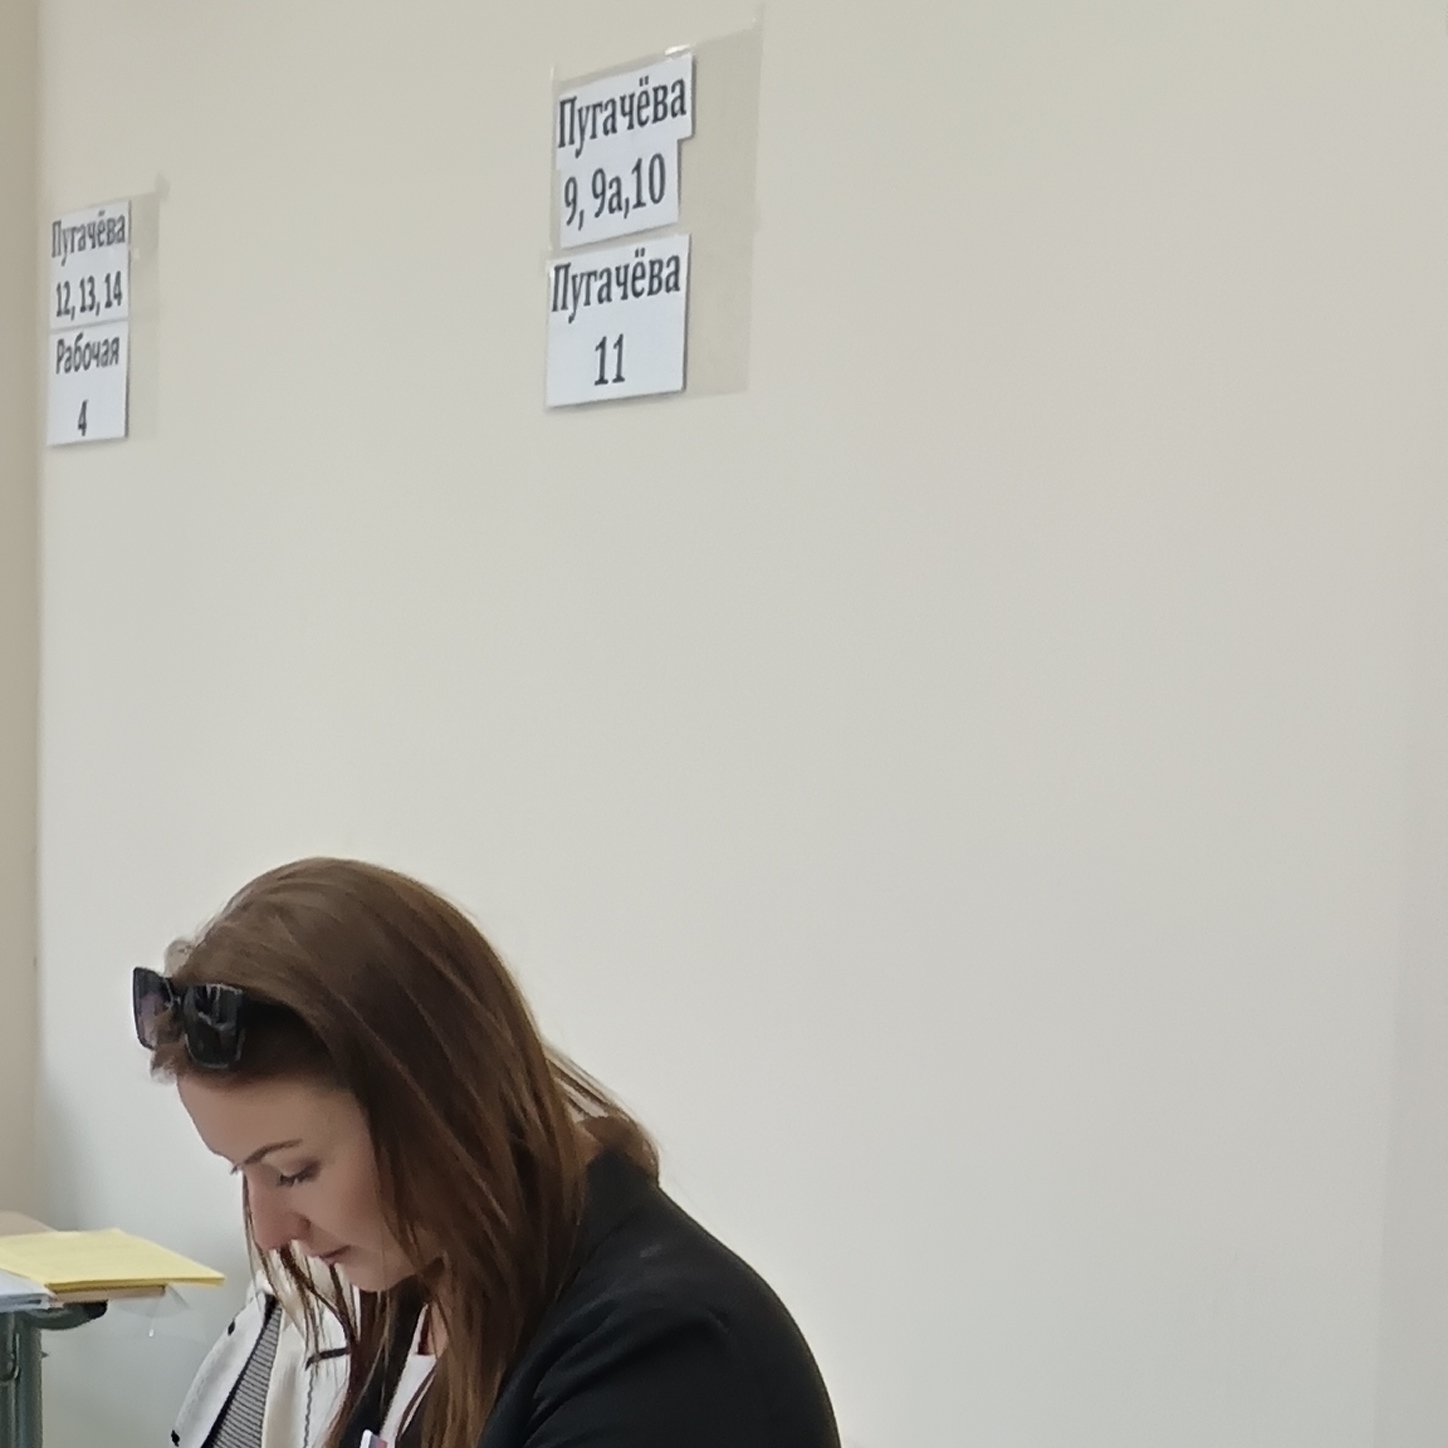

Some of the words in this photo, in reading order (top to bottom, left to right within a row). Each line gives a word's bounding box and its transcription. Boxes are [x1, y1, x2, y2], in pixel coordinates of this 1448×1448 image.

[557, 76, 687, 158] Пугачёва
[564, 175, 585, 231] 9,
[591, 153, 666, 219] 9а,10
[51, 209, 126, 266] Пугачёва
[56, 280, 76, 321] 12,
[79, 275, 101, 316] 13,
[104, 270, 123, 309] 14
[551, 247, 681, 324] Пугачёва
[55, 332, 121, 374] Рабочая
[594, 333, 626, 386] 11
[77, 399, 89, 436] 4
